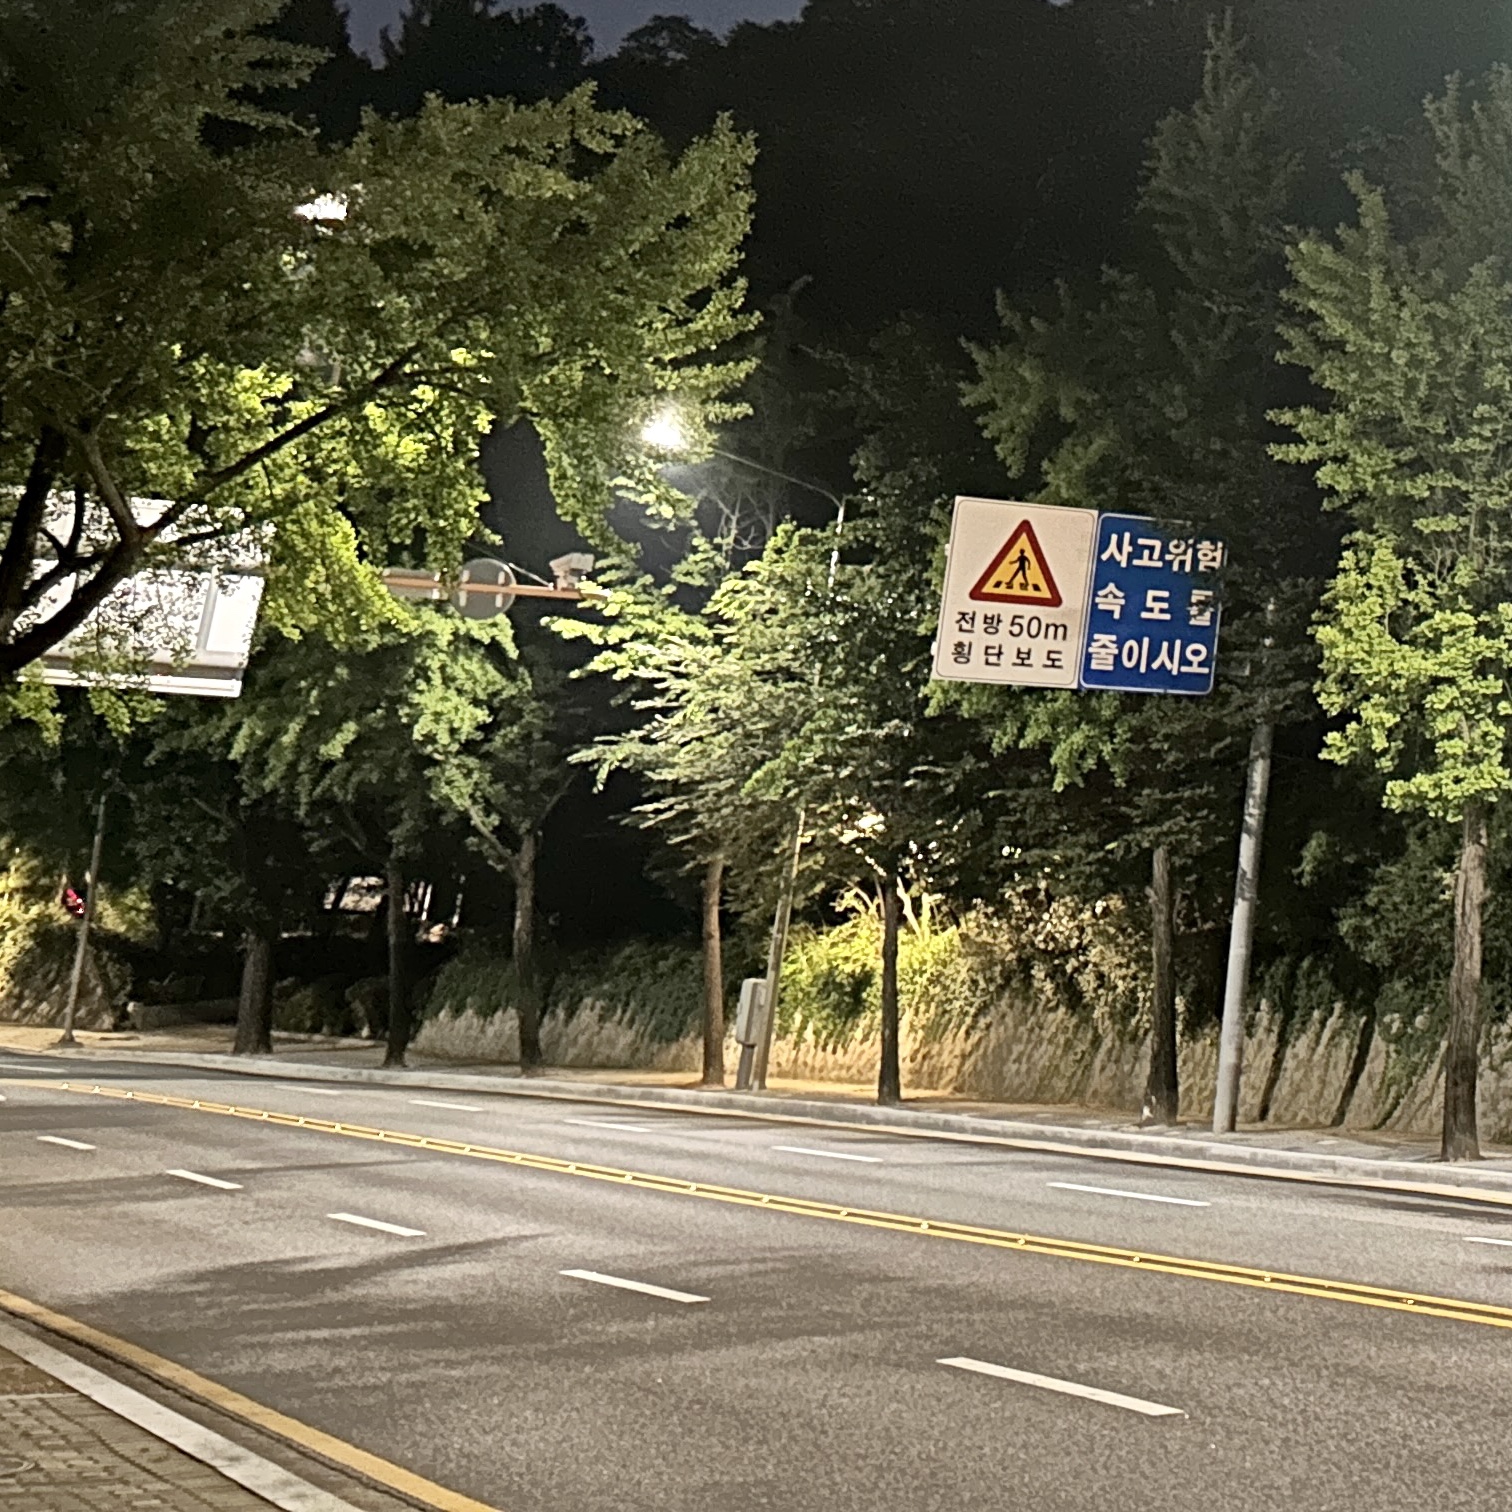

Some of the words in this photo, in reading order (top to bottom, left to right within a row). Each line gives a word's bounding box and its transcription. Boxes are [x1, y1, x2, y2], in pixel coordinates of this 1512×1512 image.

[1100, 531, 1224, 573] 사고위험
[955, 610, 1003, 636] 전방
[1008, 614, 1068, 641] 50m
[951, 640, 1064, 669] 횡단보도
[1088, 633, 1210, 676] 줄이시오
